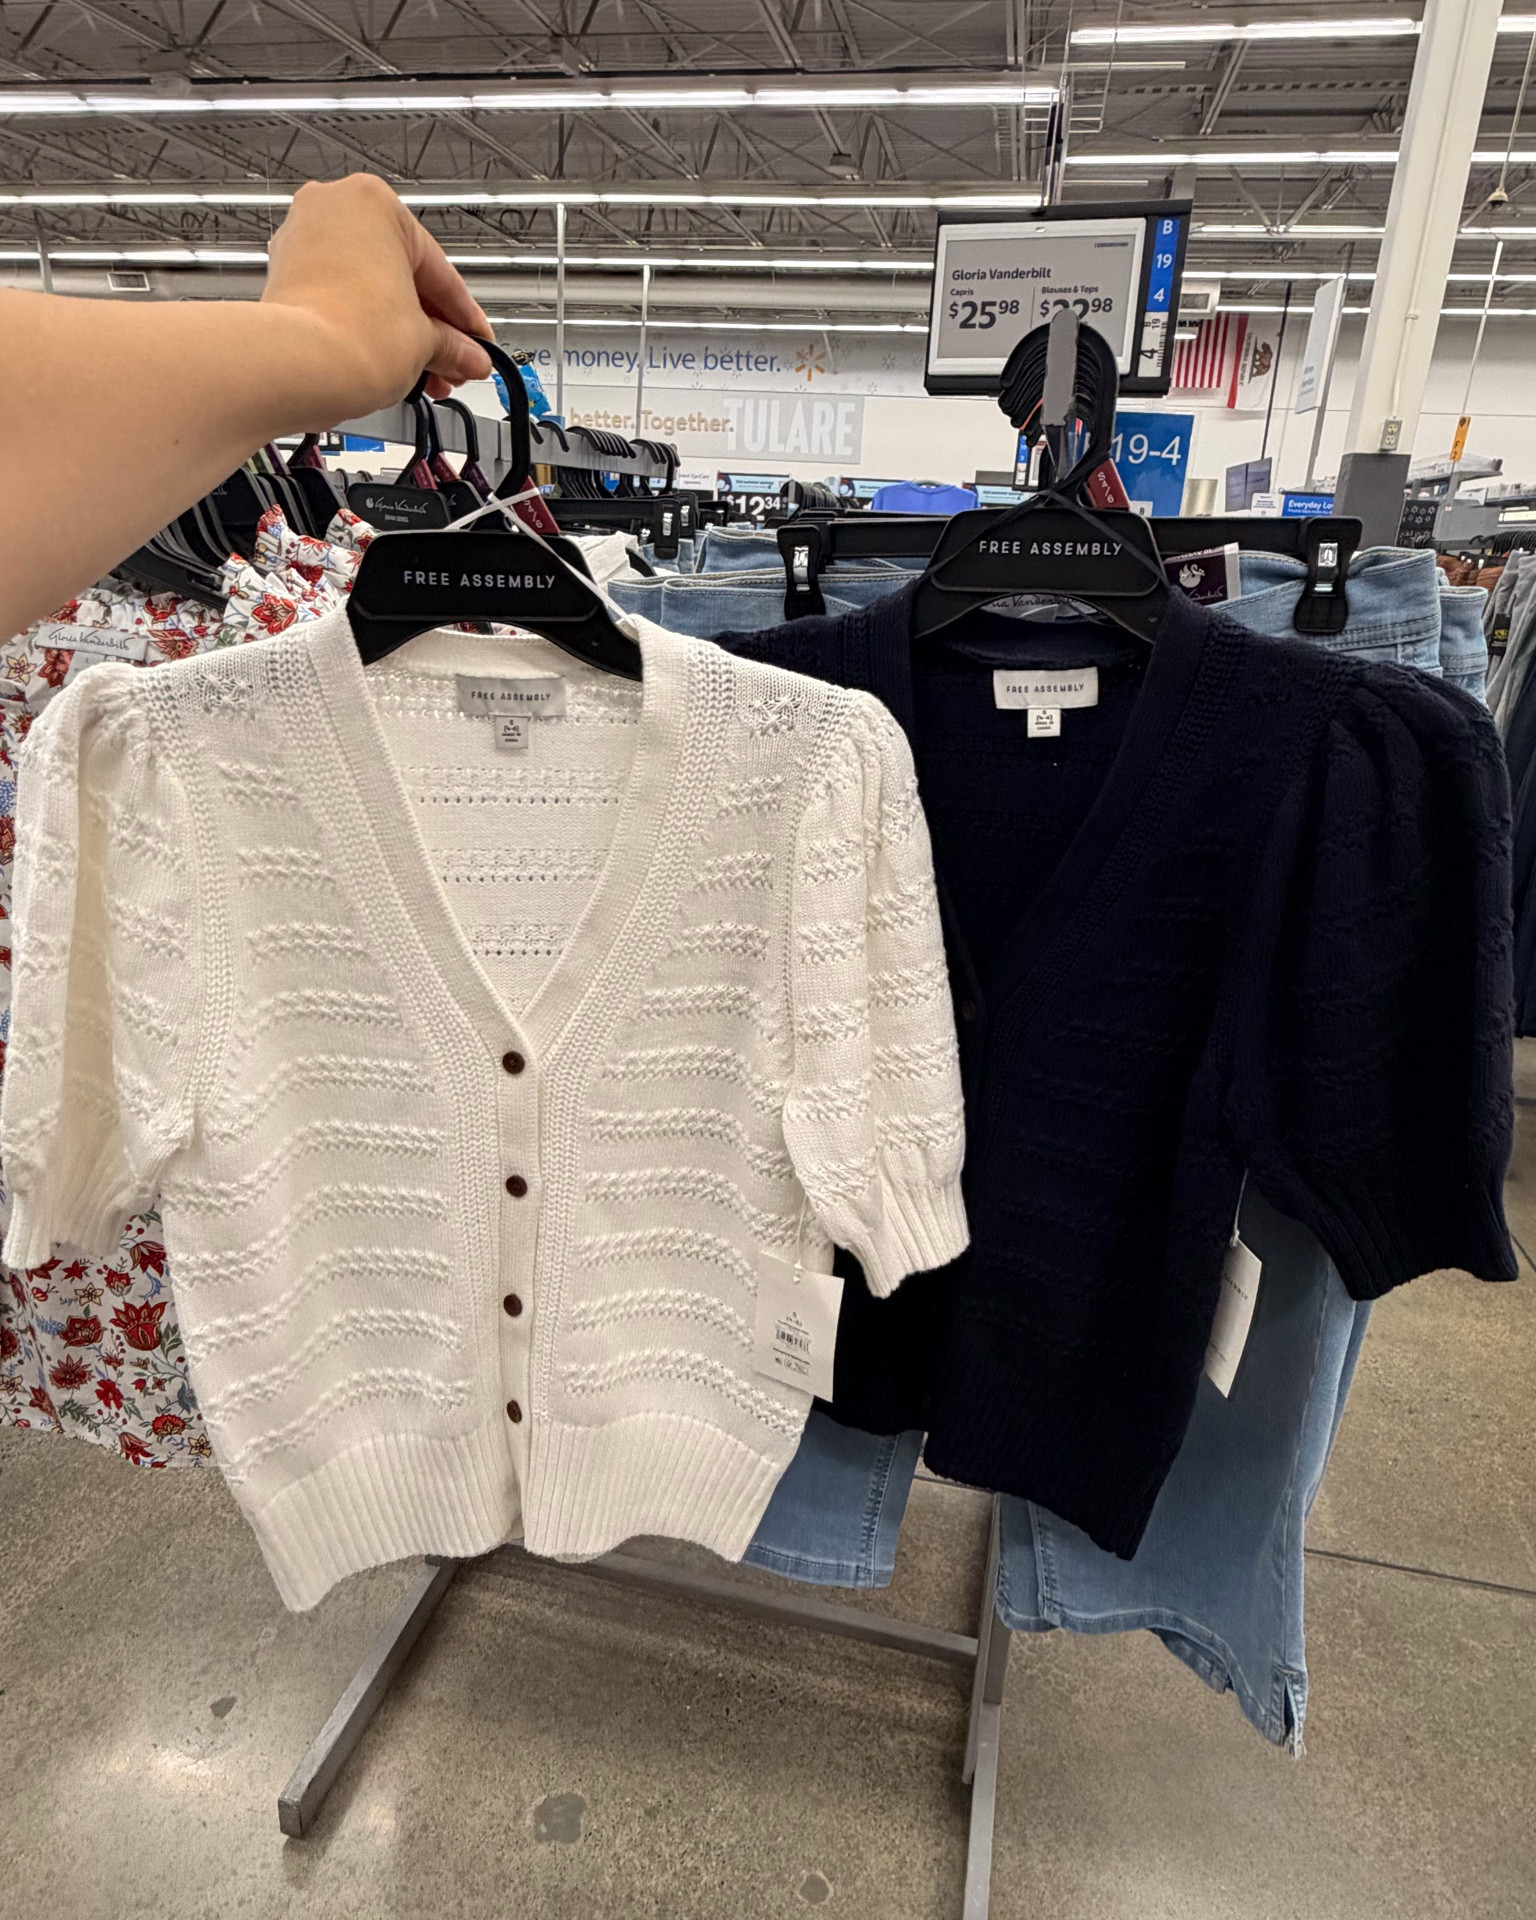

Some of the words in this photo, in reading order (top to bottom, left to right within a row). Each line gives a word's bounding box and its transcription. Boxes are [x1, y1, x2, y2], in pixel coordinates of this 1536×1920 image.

[1162, 220, 1173, 235] B
[1156, 254, 1173, 269] 19
[952, 268, 987, 281] Gloria
[989, 266, 1052, 280] Vanderbilt
[950, 288, 974, 297] Capris
[1041, 286, 1072, 294] Blouses
[1080, 285, 1099, 295] Tops
[1153, 289, 1165, 303] 4
[565, 350, 640, 373] money.
[650, 346, 695, 370] Live
[703, 346, 781, 373] better.
[570, 407, 635, 430] better.
[642, 410, 734, 436] Together.
[723, 398, 856, 456] TULARE
[1110, 432, 1182, 467] 19-4
[1288, 500, 1322, 511] Everyday
[979, 540, 1021, 554] FREE
[1030, 542, 1123, 556] ASSEMBLY
[403, 570, 450, 587] FREE
[460, 571, 556, 589] ASSEMBLY
[471, 690, 495, 700] FREE
[500, 692, 551, 701] ASSEMBLY
[1006, 685, 1029, 693] FREE
[1034, 683, 1084, 693] ASSEMBLY
